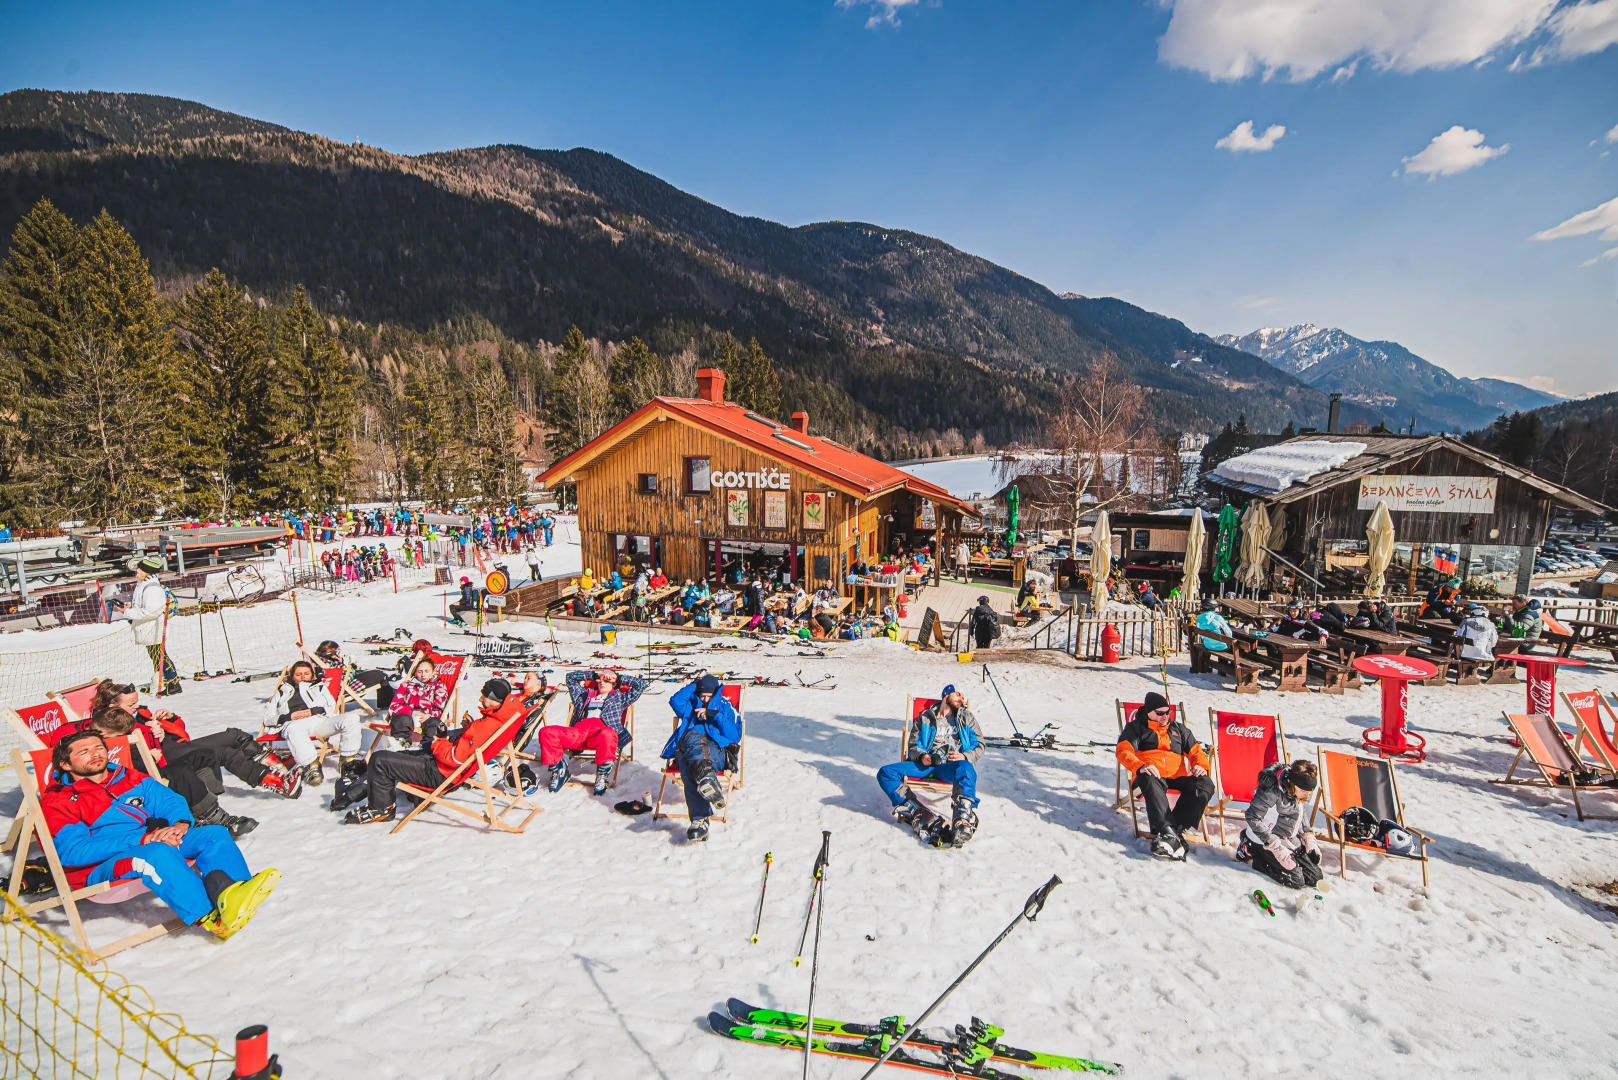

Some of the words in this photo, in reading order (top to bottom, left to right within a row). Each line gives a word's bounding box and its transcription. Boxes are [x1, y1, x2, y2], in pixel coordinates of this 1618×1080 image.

[710, 467, 791, 490] GOSTIŠČE
[1361, 483, 1441, 498] BEDANČEVA
[1448, 484, 1493, 500] ŠTALA
[28, 708, 61, 736] Coca-Cola
[1226, 722, 1267, 739] Coca-Cola
